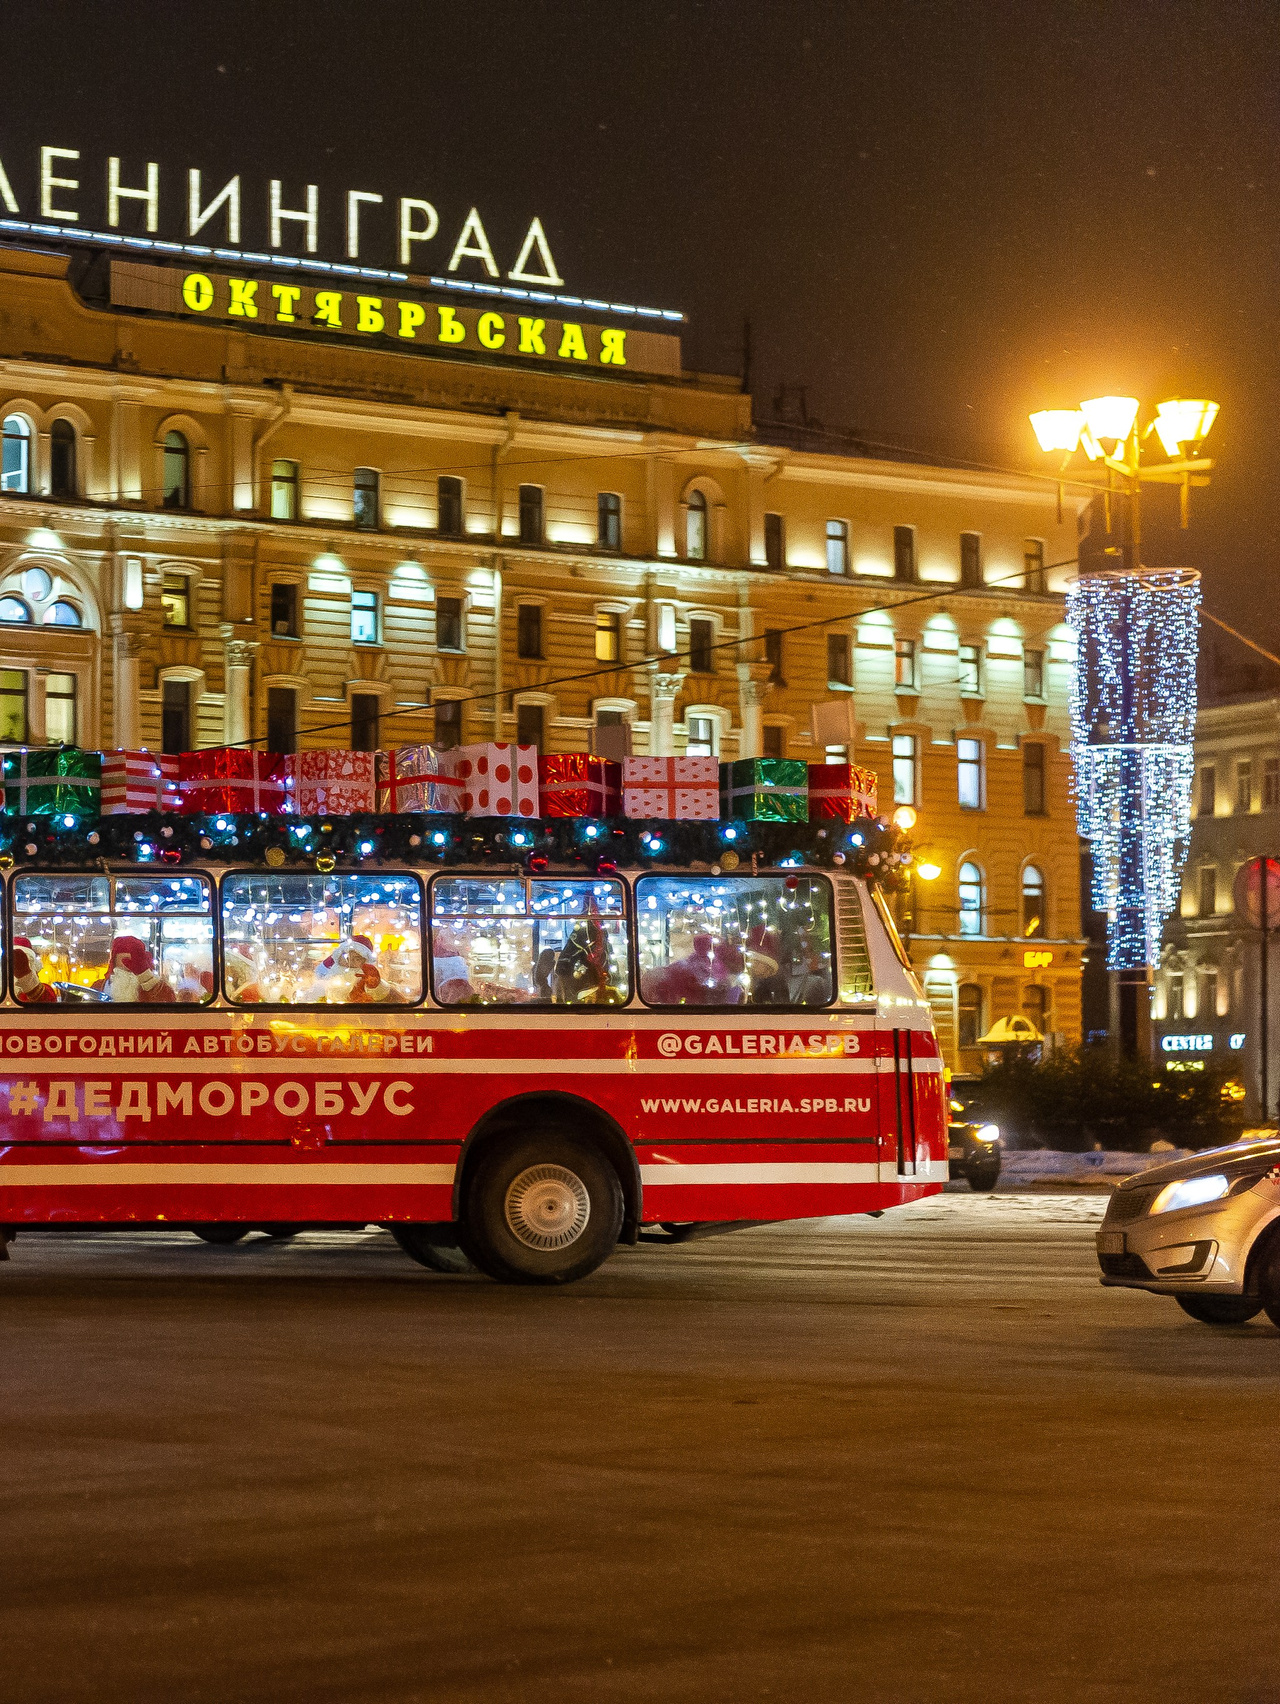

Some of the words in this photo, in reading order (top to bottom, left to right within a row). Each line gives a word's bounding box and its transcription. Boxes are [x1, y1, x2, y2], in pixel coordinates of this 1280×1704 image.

[182, 272, 627, 367] ОКТЯБРЬСКАЯ
[1024, 951, 1054, 968] БАР
[183, 1034, 307, 1054] АВТОБУС
[317, 1034, 434, 1054] ГАЛЕРЕИ
[656, 1032, 861, 1058] @GALERIASPB
[8, 1080, 416, 1123] #ДЕДМОРОБУС
[639, 1097, 872, 1114] WWW.GALERIA.SPB.RU
